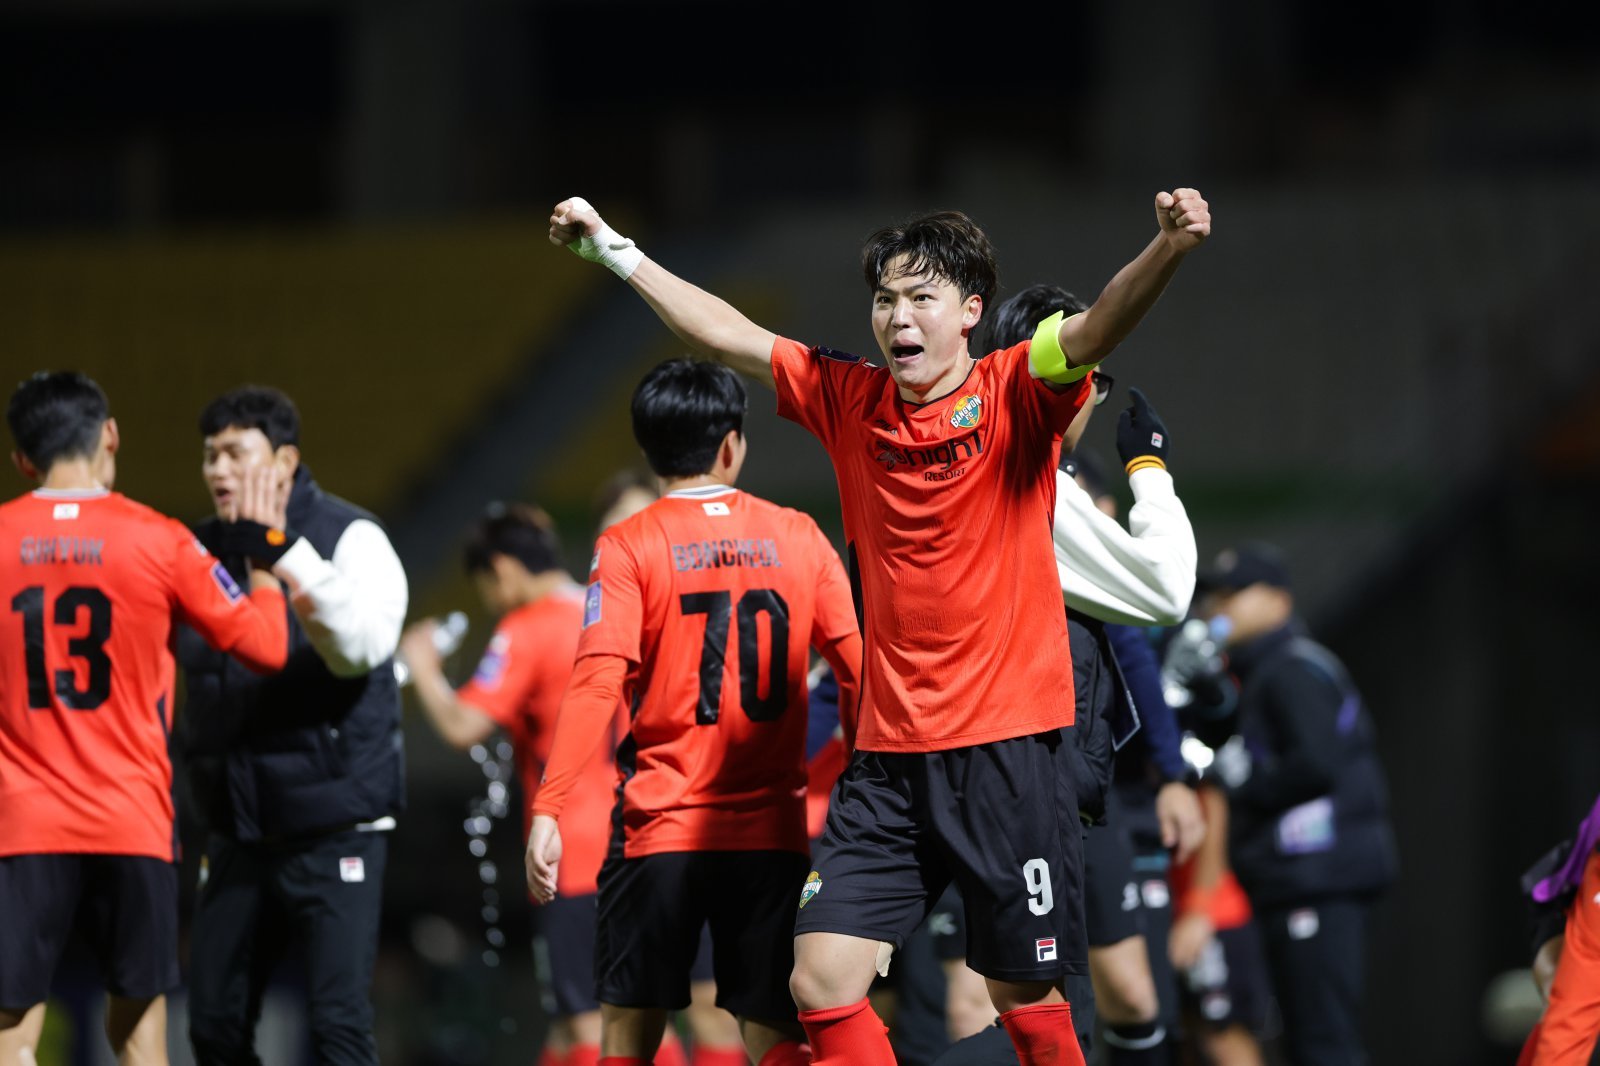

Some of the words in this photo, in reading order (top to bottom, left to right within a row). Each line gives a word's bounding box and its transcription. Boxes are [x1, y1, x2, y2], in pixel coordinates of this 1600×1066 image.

[20, 535, 104, 566] GIHYUK
[672, 538, 782, 572] BONCHEUL
[11, 585, 112, 710] 13
[679, 588, 790, 726] 70
[1022, 857, 1054, 916] 9
